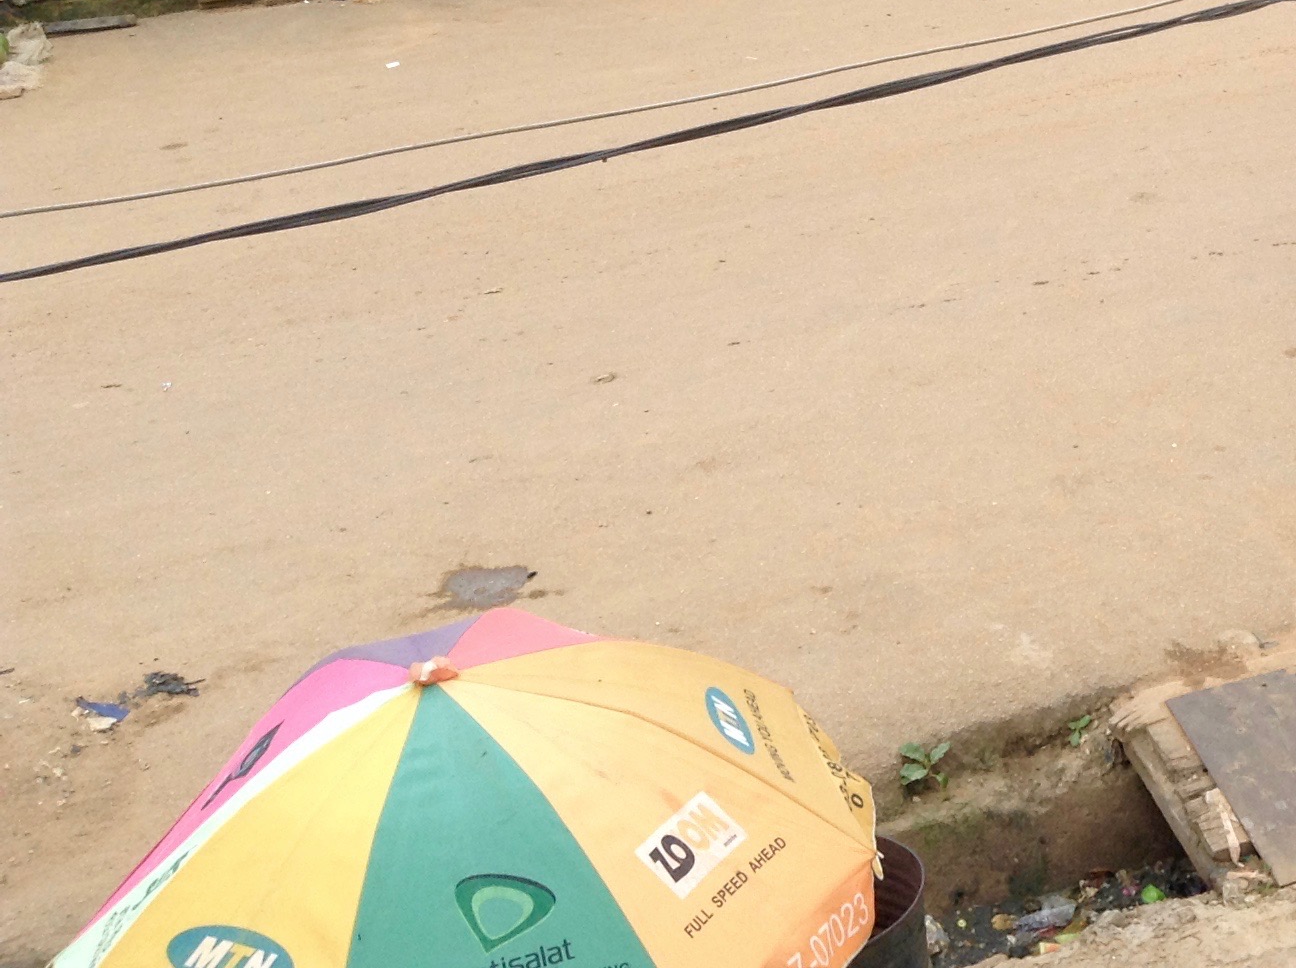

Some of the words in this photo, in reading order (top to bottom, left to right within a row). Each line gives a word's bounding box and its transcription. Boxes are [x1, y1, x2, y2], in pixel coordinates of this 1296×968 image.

[710, 695, 750, 747] MTN
[649, 802, 730, 883] ZOOM
[684, 909, 714, 938] FULL
[711, 870, 749, 908] SPEED
[748, 836, 787, 873] AHEAD
[184, 936, 278, 968] MTN
